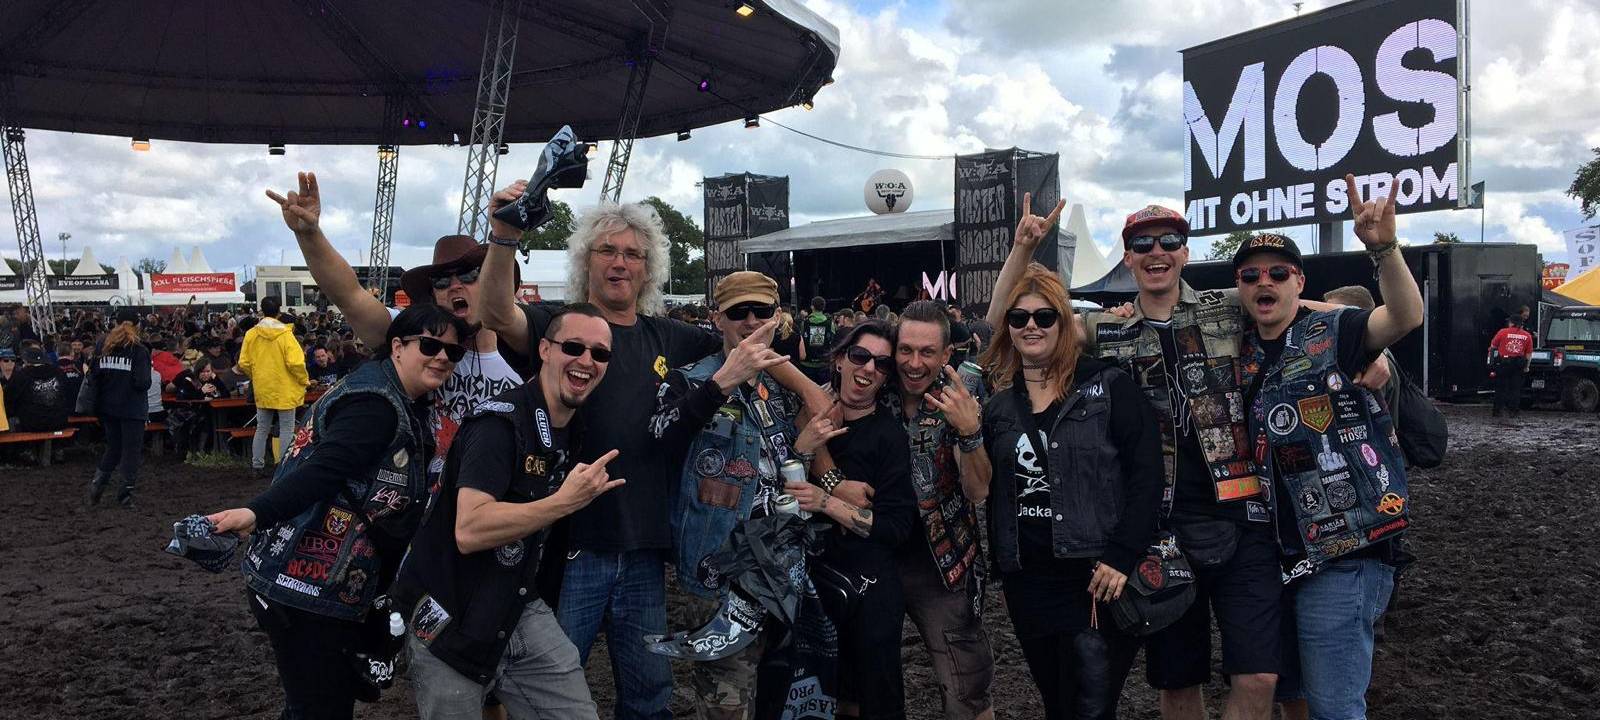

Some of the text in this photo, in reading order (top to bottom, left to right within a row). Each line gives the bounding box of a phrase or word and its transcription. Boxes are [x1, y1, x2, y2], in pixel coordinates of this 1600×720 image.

[1183, 18, 1457, 192] MOS
[708, 204, 743, 237] FASTER
[960, 184, 1006, 224] FASTER
[1229, 182, 1315, 225] OHNE
[960, 227, 1010, 267] HARDER
[154, 279, 171, 288] XXL
[537, 411, 551, 446] CLUTCH
[1340, 431, 1367, 443] HOSEN
[275, 573, 322, 597] SCORPIONS
